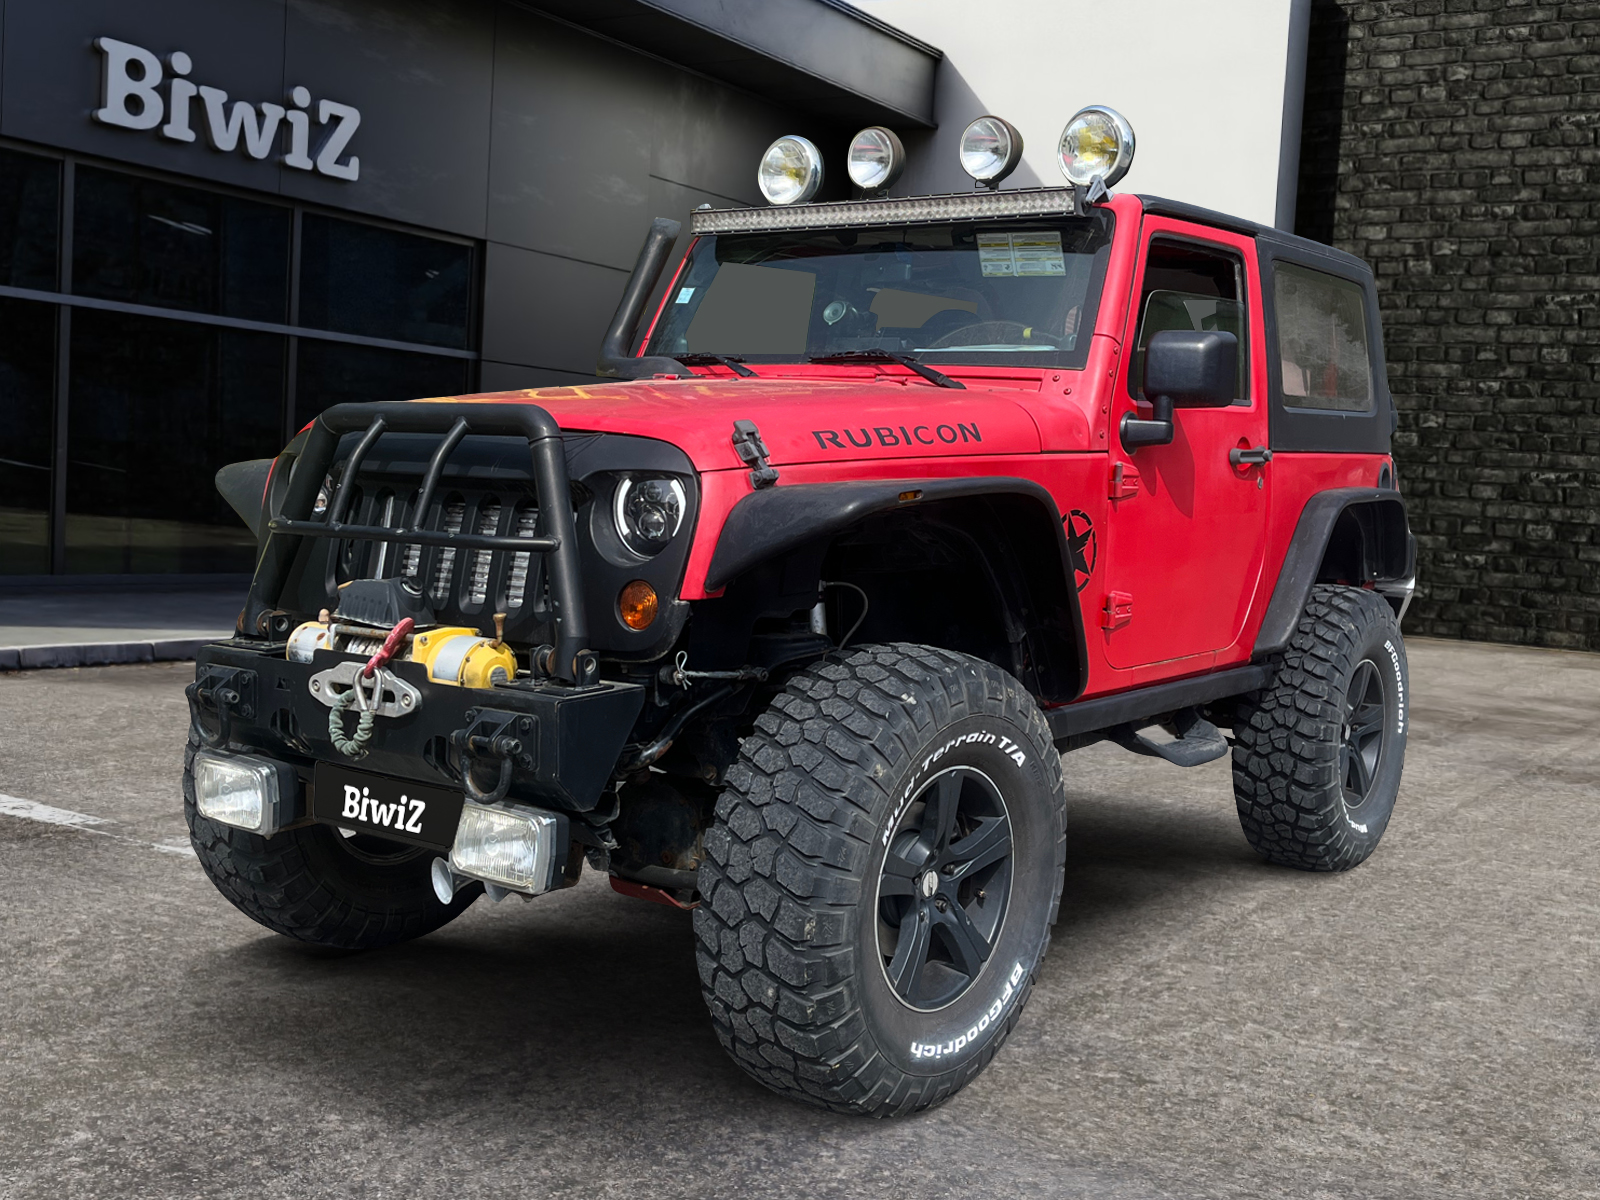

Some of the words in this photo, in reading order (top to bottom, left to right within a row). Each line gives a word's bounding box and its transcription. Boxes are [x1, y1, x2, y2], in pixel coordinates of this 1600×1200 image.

[94, 36, 361, 182] BiwiZ
[812, 422, 983, 450] RUBICON
[1384, 639, 1404, 734] BFGoodrich
[998, 736, 1027, 768] T/A
[341, 784, 426, 834] BiwiZ
[910, 962, 1024, 1059] BFGoodrich
